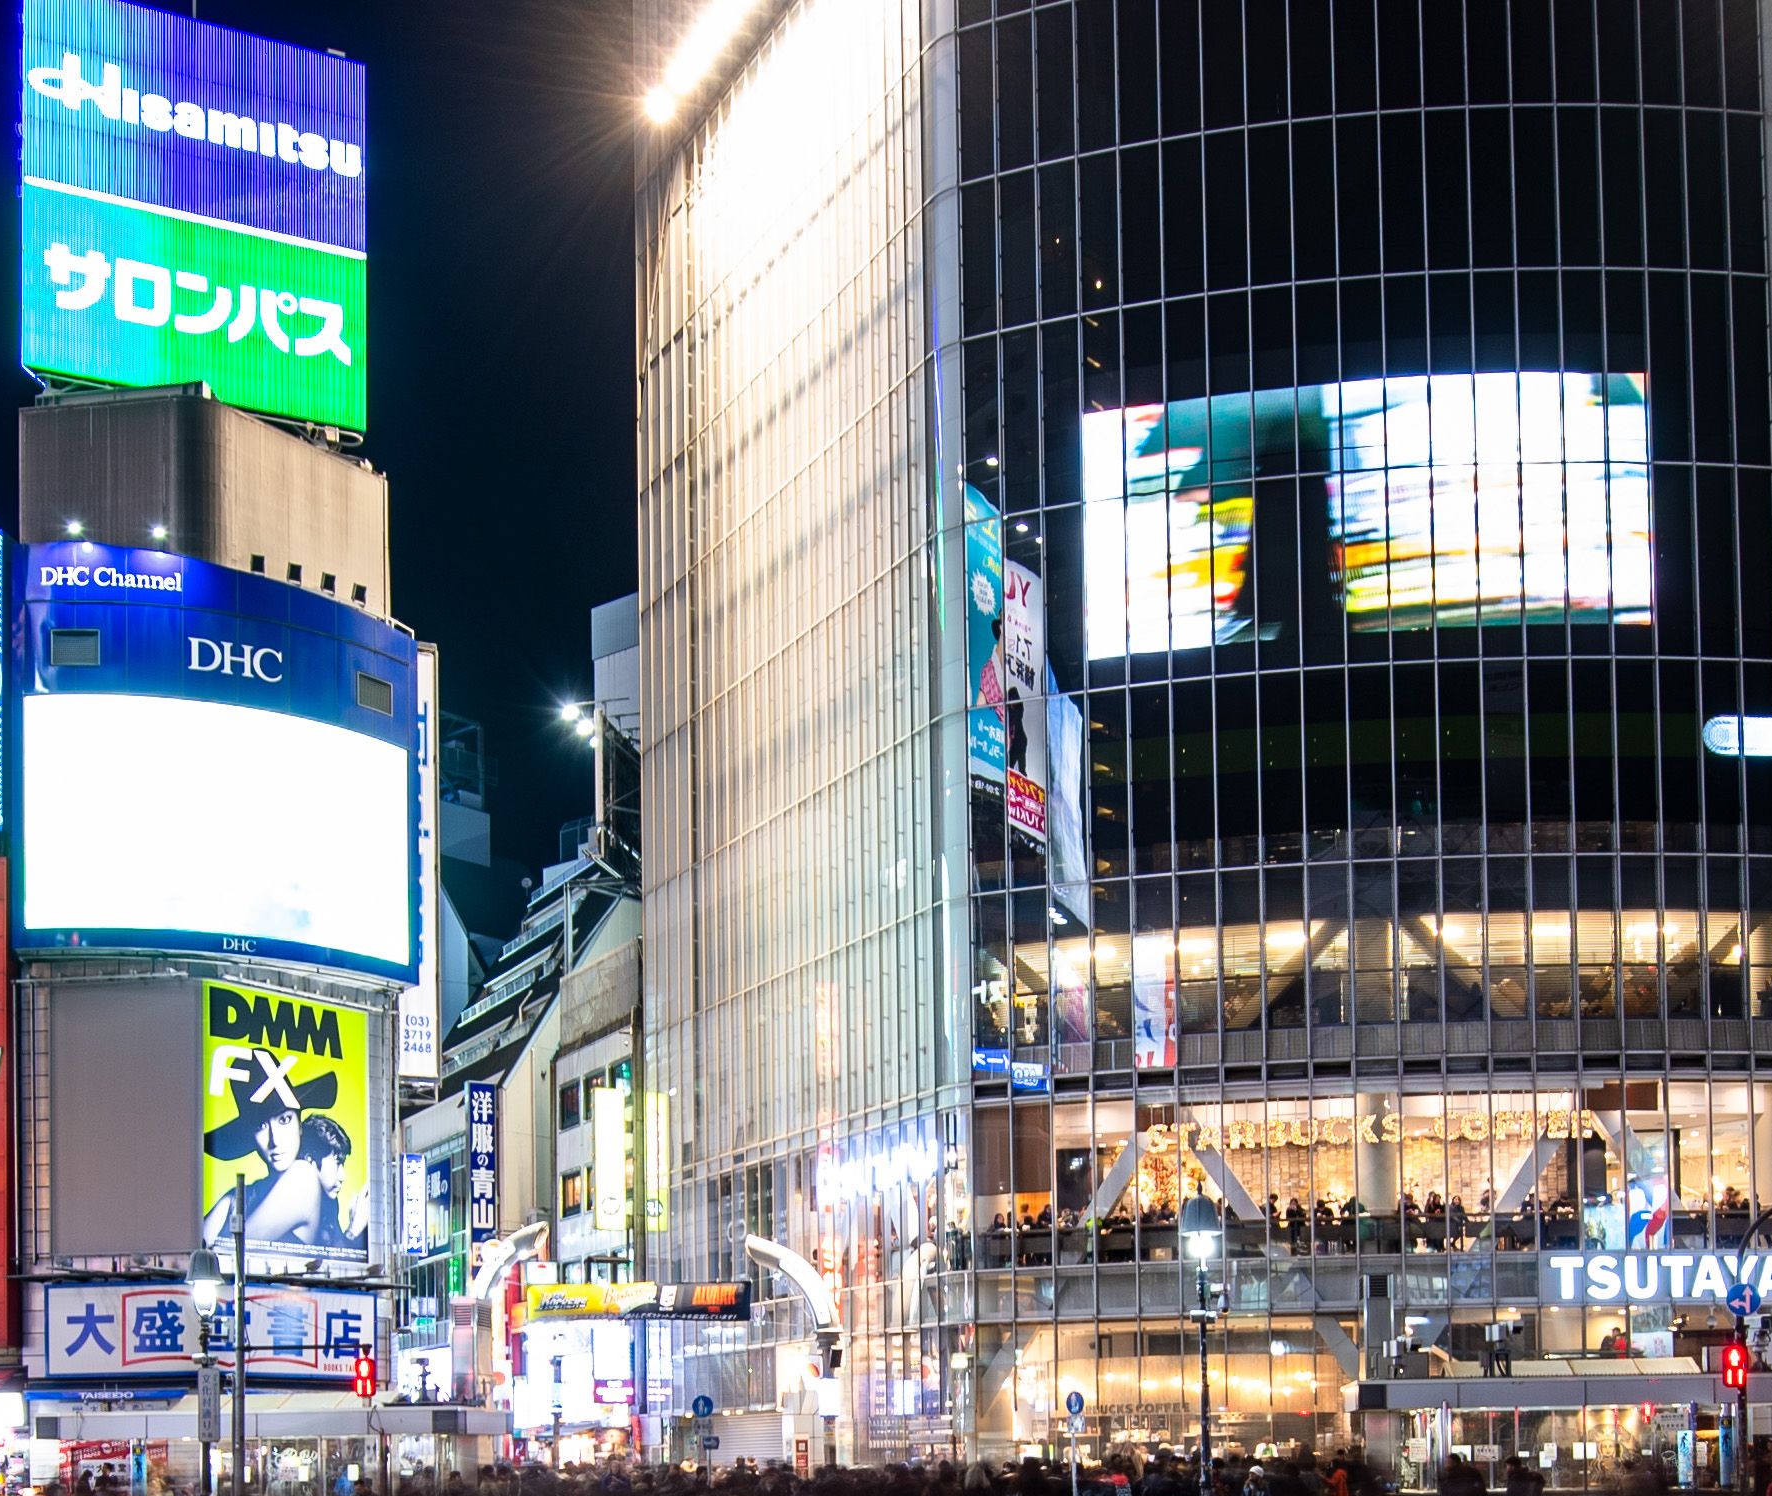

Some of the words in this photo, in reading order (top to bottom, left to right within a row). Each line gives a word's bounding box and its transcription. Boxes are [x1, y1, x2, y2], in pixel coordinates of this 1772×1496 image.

[27, 52, 361, 179] Hisamitsu
[44, 242, 353, 367] サロンパス
[40, 566, 90, 588] DHC
[93, 566, 183, 593] Channel
[188, 636, 284, 683] DHC
[221, 936, 257, 953] DHC
[209, 985, 344, 1060] DMM
[403, 1029, 432, 1040] 3719
[405, 1014, 429, 1027] (03)
[403, 1041, 432, 1053] 2468
[208, 1045, 301, 1110] FX
[1146, 1111, 1406, 1154] STARBUCKS
[1432, 1109, 1593, 1141] COFFEE
[470, 1090, 496, 1230] 洋服の青山
[691, 1285, 738, 1306] ALVARK
[323, 1363, 344, 1373] BOOKS
[1135, 1402, 1191, 1415] COFFEE
